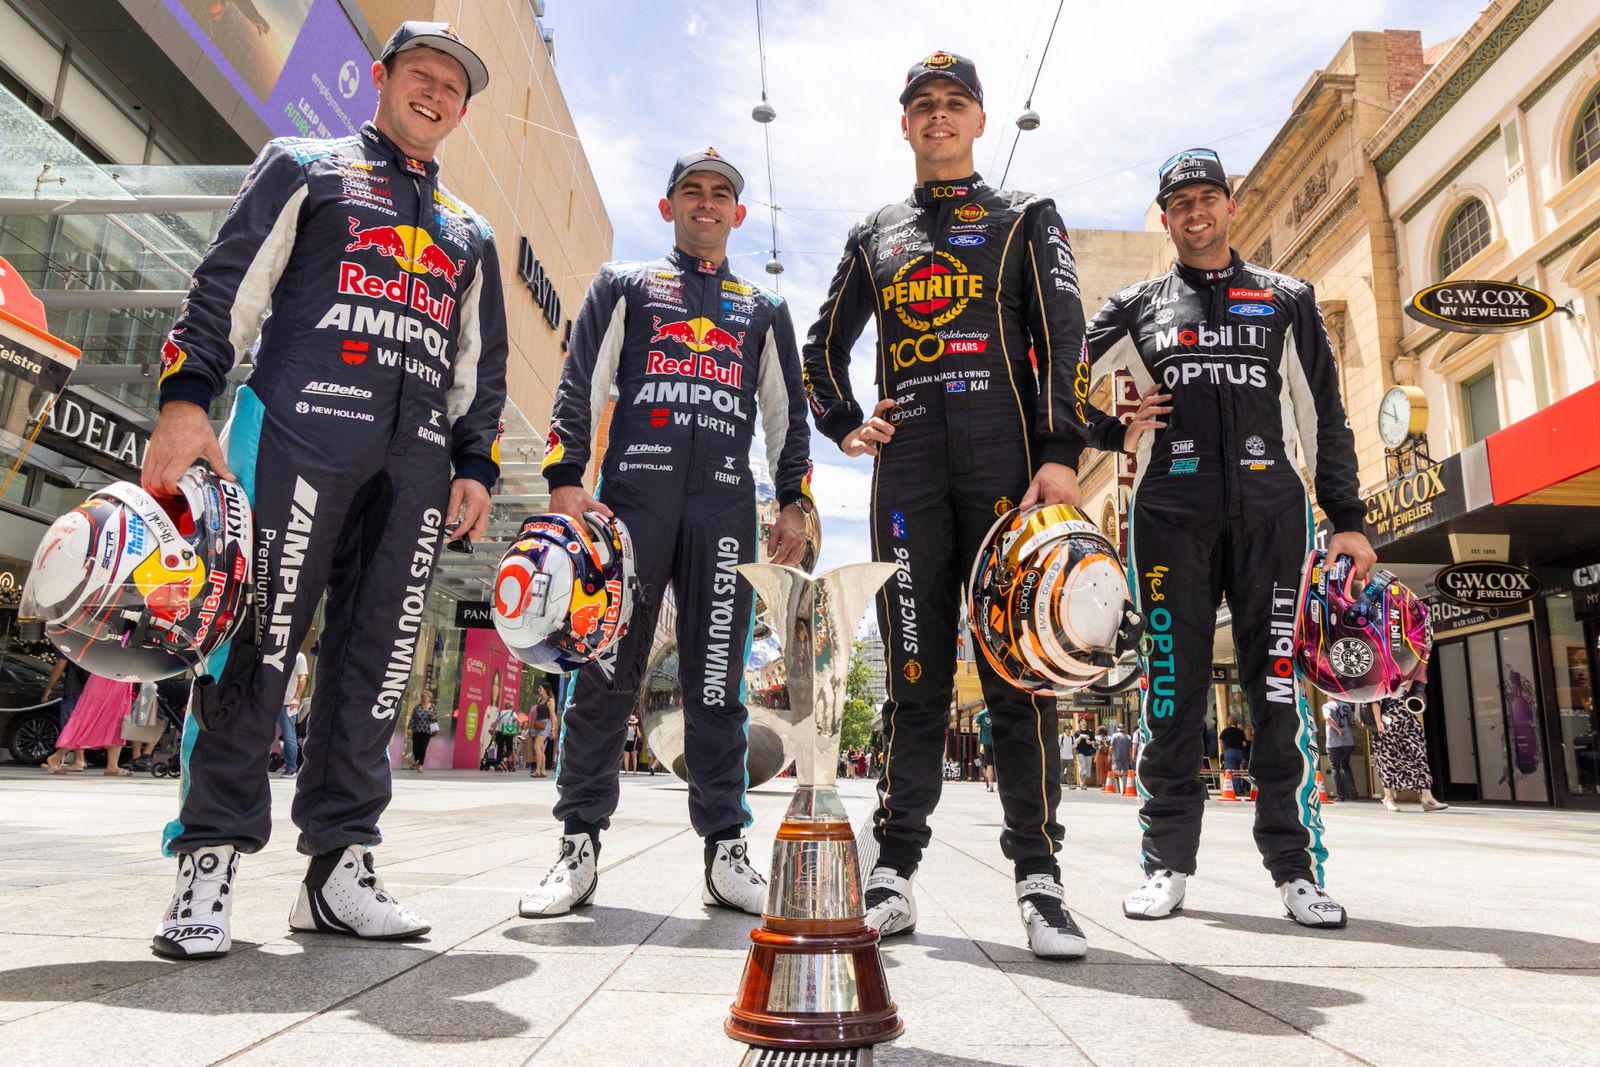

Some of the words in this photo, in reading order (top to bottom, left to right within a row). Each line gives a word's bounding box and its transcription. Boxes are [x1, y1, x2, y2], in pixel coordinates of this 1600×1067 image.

[924, 54, 957, 66] PENRITE
[284, 102, 311, 137] FUTURE
[298, 97, 319, 124] LEAP
[342, 177, 372, 192] Shaw
[1172, 170, 1207, 184] OPTUS
[342, 186, 393, 206] Partners
[931, 186, 955, 198] 100
[350, 198, 398, 217] FREIGHTER
[955, 208, 989, 217] PENRITE
[442, 232, 469, 251] JGI
[885, 227, 918, 245] APEX
[880, 241, 921, 260] GROVE
[518, 236, 562, 331] DAVID
[1206, 270, 1227, 281] Mobil
[338, 261, 409, 305] Red
[411, 277, 456, 330] Bull
[648, 292, 682, 304] Partners
[882, 274, 983, 311] PENRITE
[1231, 289, 1270, 298] MORRIS
[1436, 289, 1481, 305] G.W.
[1482, 290, 1529, 306] COX
[649, 302, 688, 314] FREIGHTER
[725, 315, 750, 326] JGI
[1440, 306, 1457, 316] MY
[1462, 307, 1530, 318] JEWELLER
[315, 303, 451, 370] AMPOL
[936, 331, 991, 342] Celebrating
[950, 342, 979, 351] YEARS
[1155, 325, 1233, 351] Mobil
[889, 334, 945, 372] 100
[377, 347, 442, 388] WÜRTH
[646, 350, 698, 378] Red
[698, 354, 743, 389] Bull
[1164, 361, 1267, 390] OPTUS
[303, 381, 373, 399] ACDelco
[897, 375, 935, 392] AUSTRALIAN
[964, 370, 990, 379] OWNED
[970, 380, 988, 391] KAI
[312, 405, 333, 416] NEW
[333, 408, 375, 422] HOLLAND
[633, 381, 747, 421] AMPOL
[892, 405, 926, 422] airtouch
[418, 425, 446, 448] BROWN
[674, 411, 736, 438] WÜRTH
[626, 443, 672, 453] ACDelco
[1172, 443, 1194, 452] OMP
[629, 463, 642, 471] NEW
[642, 464, 673, 472] HOLLAND
[1172, 460, 1197, 470] 25
[714, 471, 741, 486] FEENEY
[1365, 486, 1399, 525] G.W.
[1399, 464, 1446, 508] COX
[543, 523, 564, 537] Red
[1377, 519, 1390, 535] MY
[1393, 502, 1433, 531] JEWELLER
[101, 530, 114, 570] SCTR
[410, 507, 442, 580] GIVES
[235, 557, 245, 580] ROSSI
[255, 528, 277, 608] Premium
[713, 536, 740, 596] GIVES
[893, 547, 913, 591] 1926
[203, 570, 228, 612] Bull
[263, 504, 313, 673] AMPLIFY
[1019, 572, 1036, 614] airtouch
[1145, 565, 1169, 602] yes
[1446, 572, 1485, 589] G.W.
[1486, 573, 1531, 590] COX
[1457, 589, 1473, 598] MY
[1476, 590, 1523, 599] JEWELLER
[399, 583, 427, 634] YOU
[605, 580, 622, 623] Bull
[708, 599, 734, 640] YOU
[900, 596, 919, 654] SINCE
[983, 596, 992, 642] boost
[1039, 602, 1047, 632] GROVE
[1389, 609, 1401, 639] Mobil
[1453, 618, 1467, 628] HAIR
[1467, 615, 1485, 625] SALON
[257, 613, 269, 648] Fue
[1150, 607, 1175, 719] OPTUS
[1266, 621, 1293, 704] Mobil
[1335, 641, 1345, 672] GUYS
[1350, 641, 1371, 674] CHEMICAL
[371, 637, 416, 721] WINGS
[702, 642, 729, 707] WINGS
[163, 926, 220, 941] OMP
